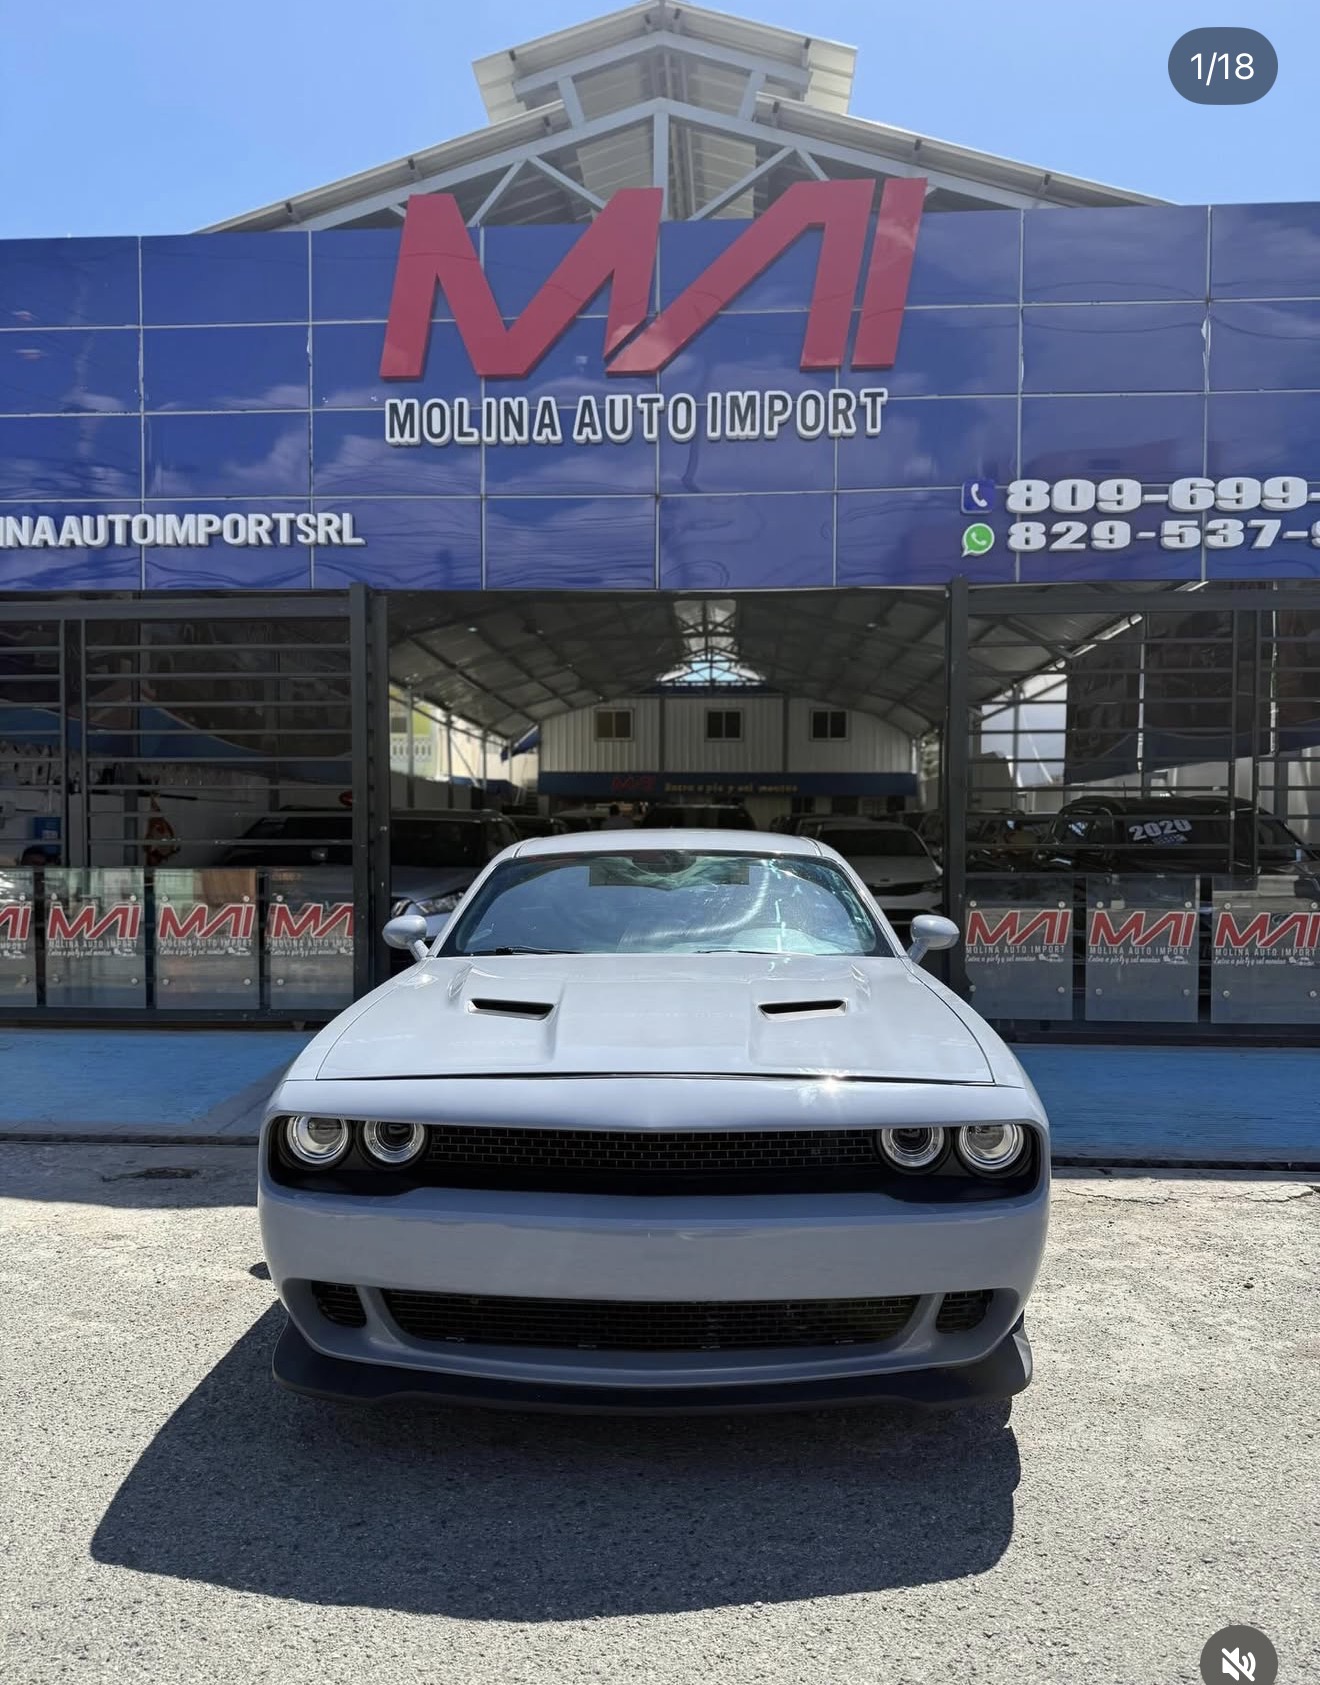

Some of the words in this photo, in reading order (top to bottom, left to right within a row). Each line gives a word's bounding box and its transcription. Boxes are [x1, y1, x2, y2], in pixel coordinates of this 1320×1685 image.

[379, 177, 929, 381] MAI
[384, 395, 563, 446] MOLINA
[572, 392, 694, 442] AUTO
[706, 387, 889, 439] IMPORT
[1006, 476, 1320, 514] 809-699-
[1007, 519, 1320, 551] 829-537-
[1128, 818, 1193, 841] 2020
[0, 905, 32, 940] AI
[48, 902, 142, 940] MAI
[159, 903, 256, 939] MAI
[271, 903, 354, 938] MA
[965, 909, 1072, 946] MAI
[1088, 910, 1197, 947] MAI
[1214, 912, 1320, 948] MAI
[0, 942, 27, 950] MPORT
[966, 945, 1000, 954] MOLINA
[1003, 945, 1027, 954] AUTO
[1031, 945, 1065, 953] IMPORT
[1089, 946, 1124, 955] MOLINA
[1128, 946, 1152, 955] AUTO
[1156, 946, 1190, 955] IMPORT
[1215, 948, 1249, 956] MOLINA
[1254, 948, 1277, 956] AUTO
[1281, 948, 1316, 956] IMPORT
